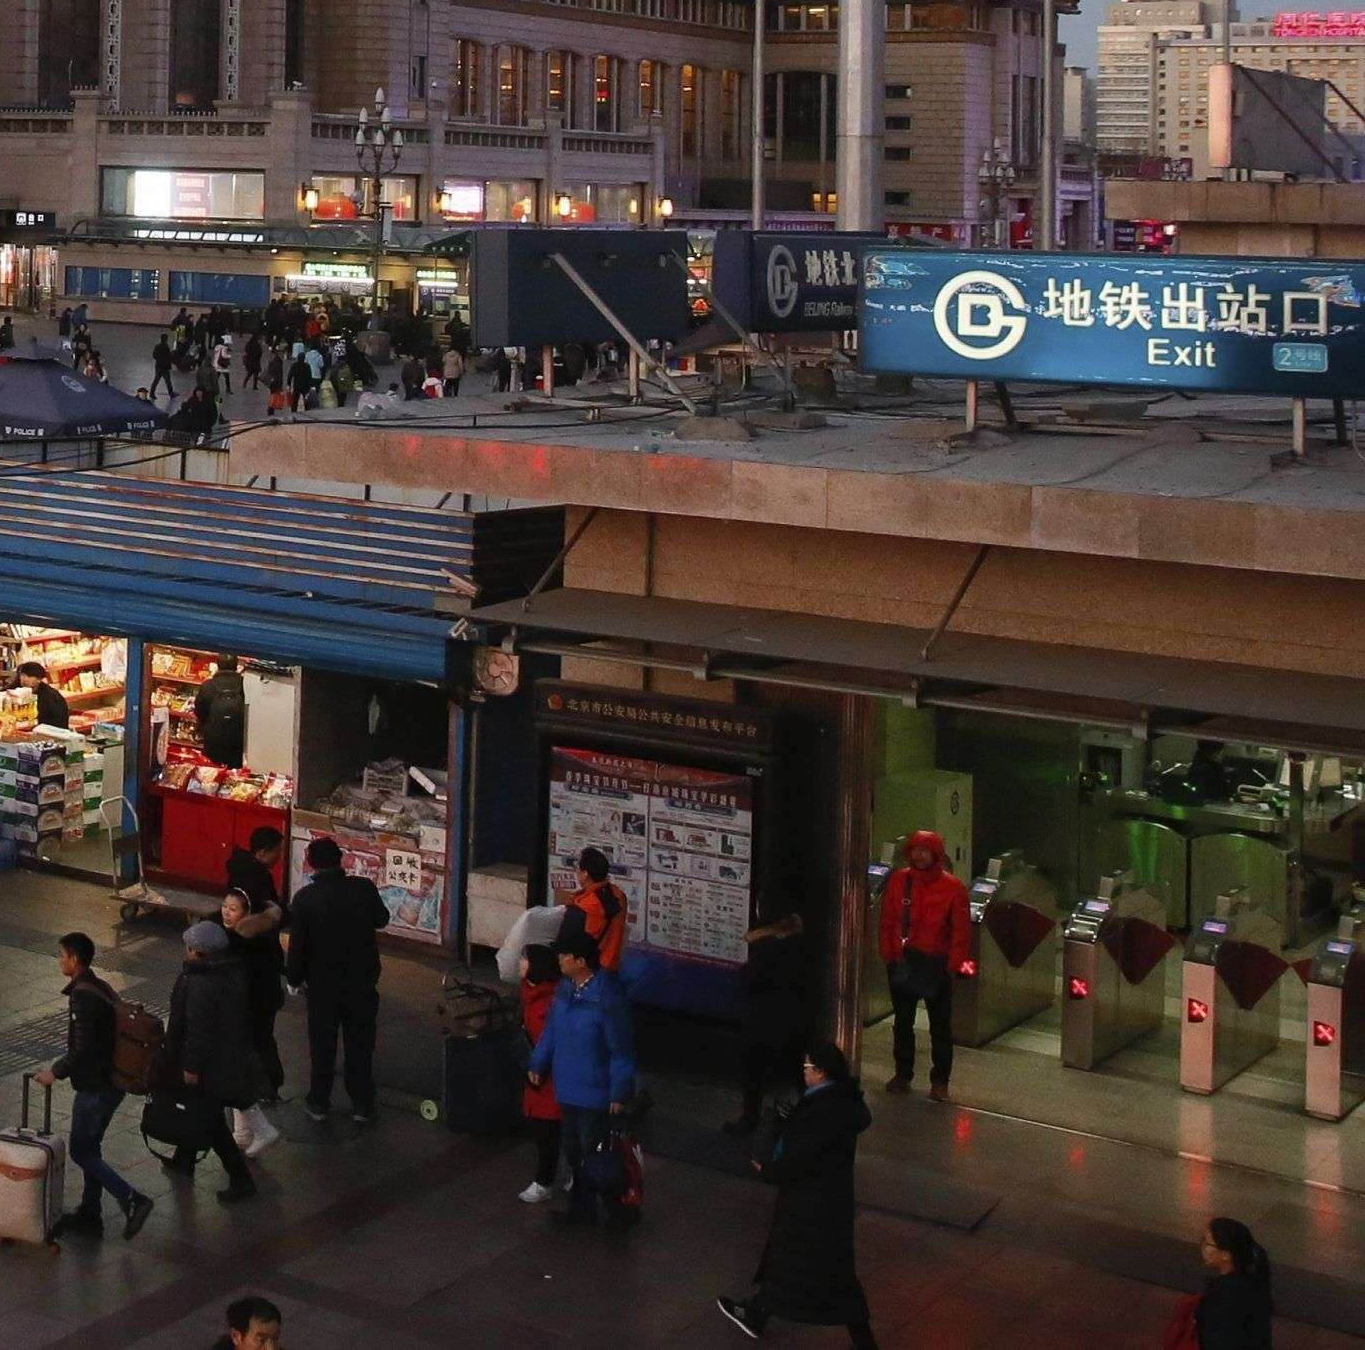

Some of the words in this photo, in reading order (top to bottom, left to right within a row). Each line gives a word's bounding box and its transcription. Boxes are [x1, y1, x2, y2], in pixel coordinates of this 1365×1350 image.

[1043, 277, 1328, 334] 地铁出站口
[1147, 338, 1217, 367] Exit
[392, 854, 419, 870] 回收
[388, 870, 418, 883] 公交卡
